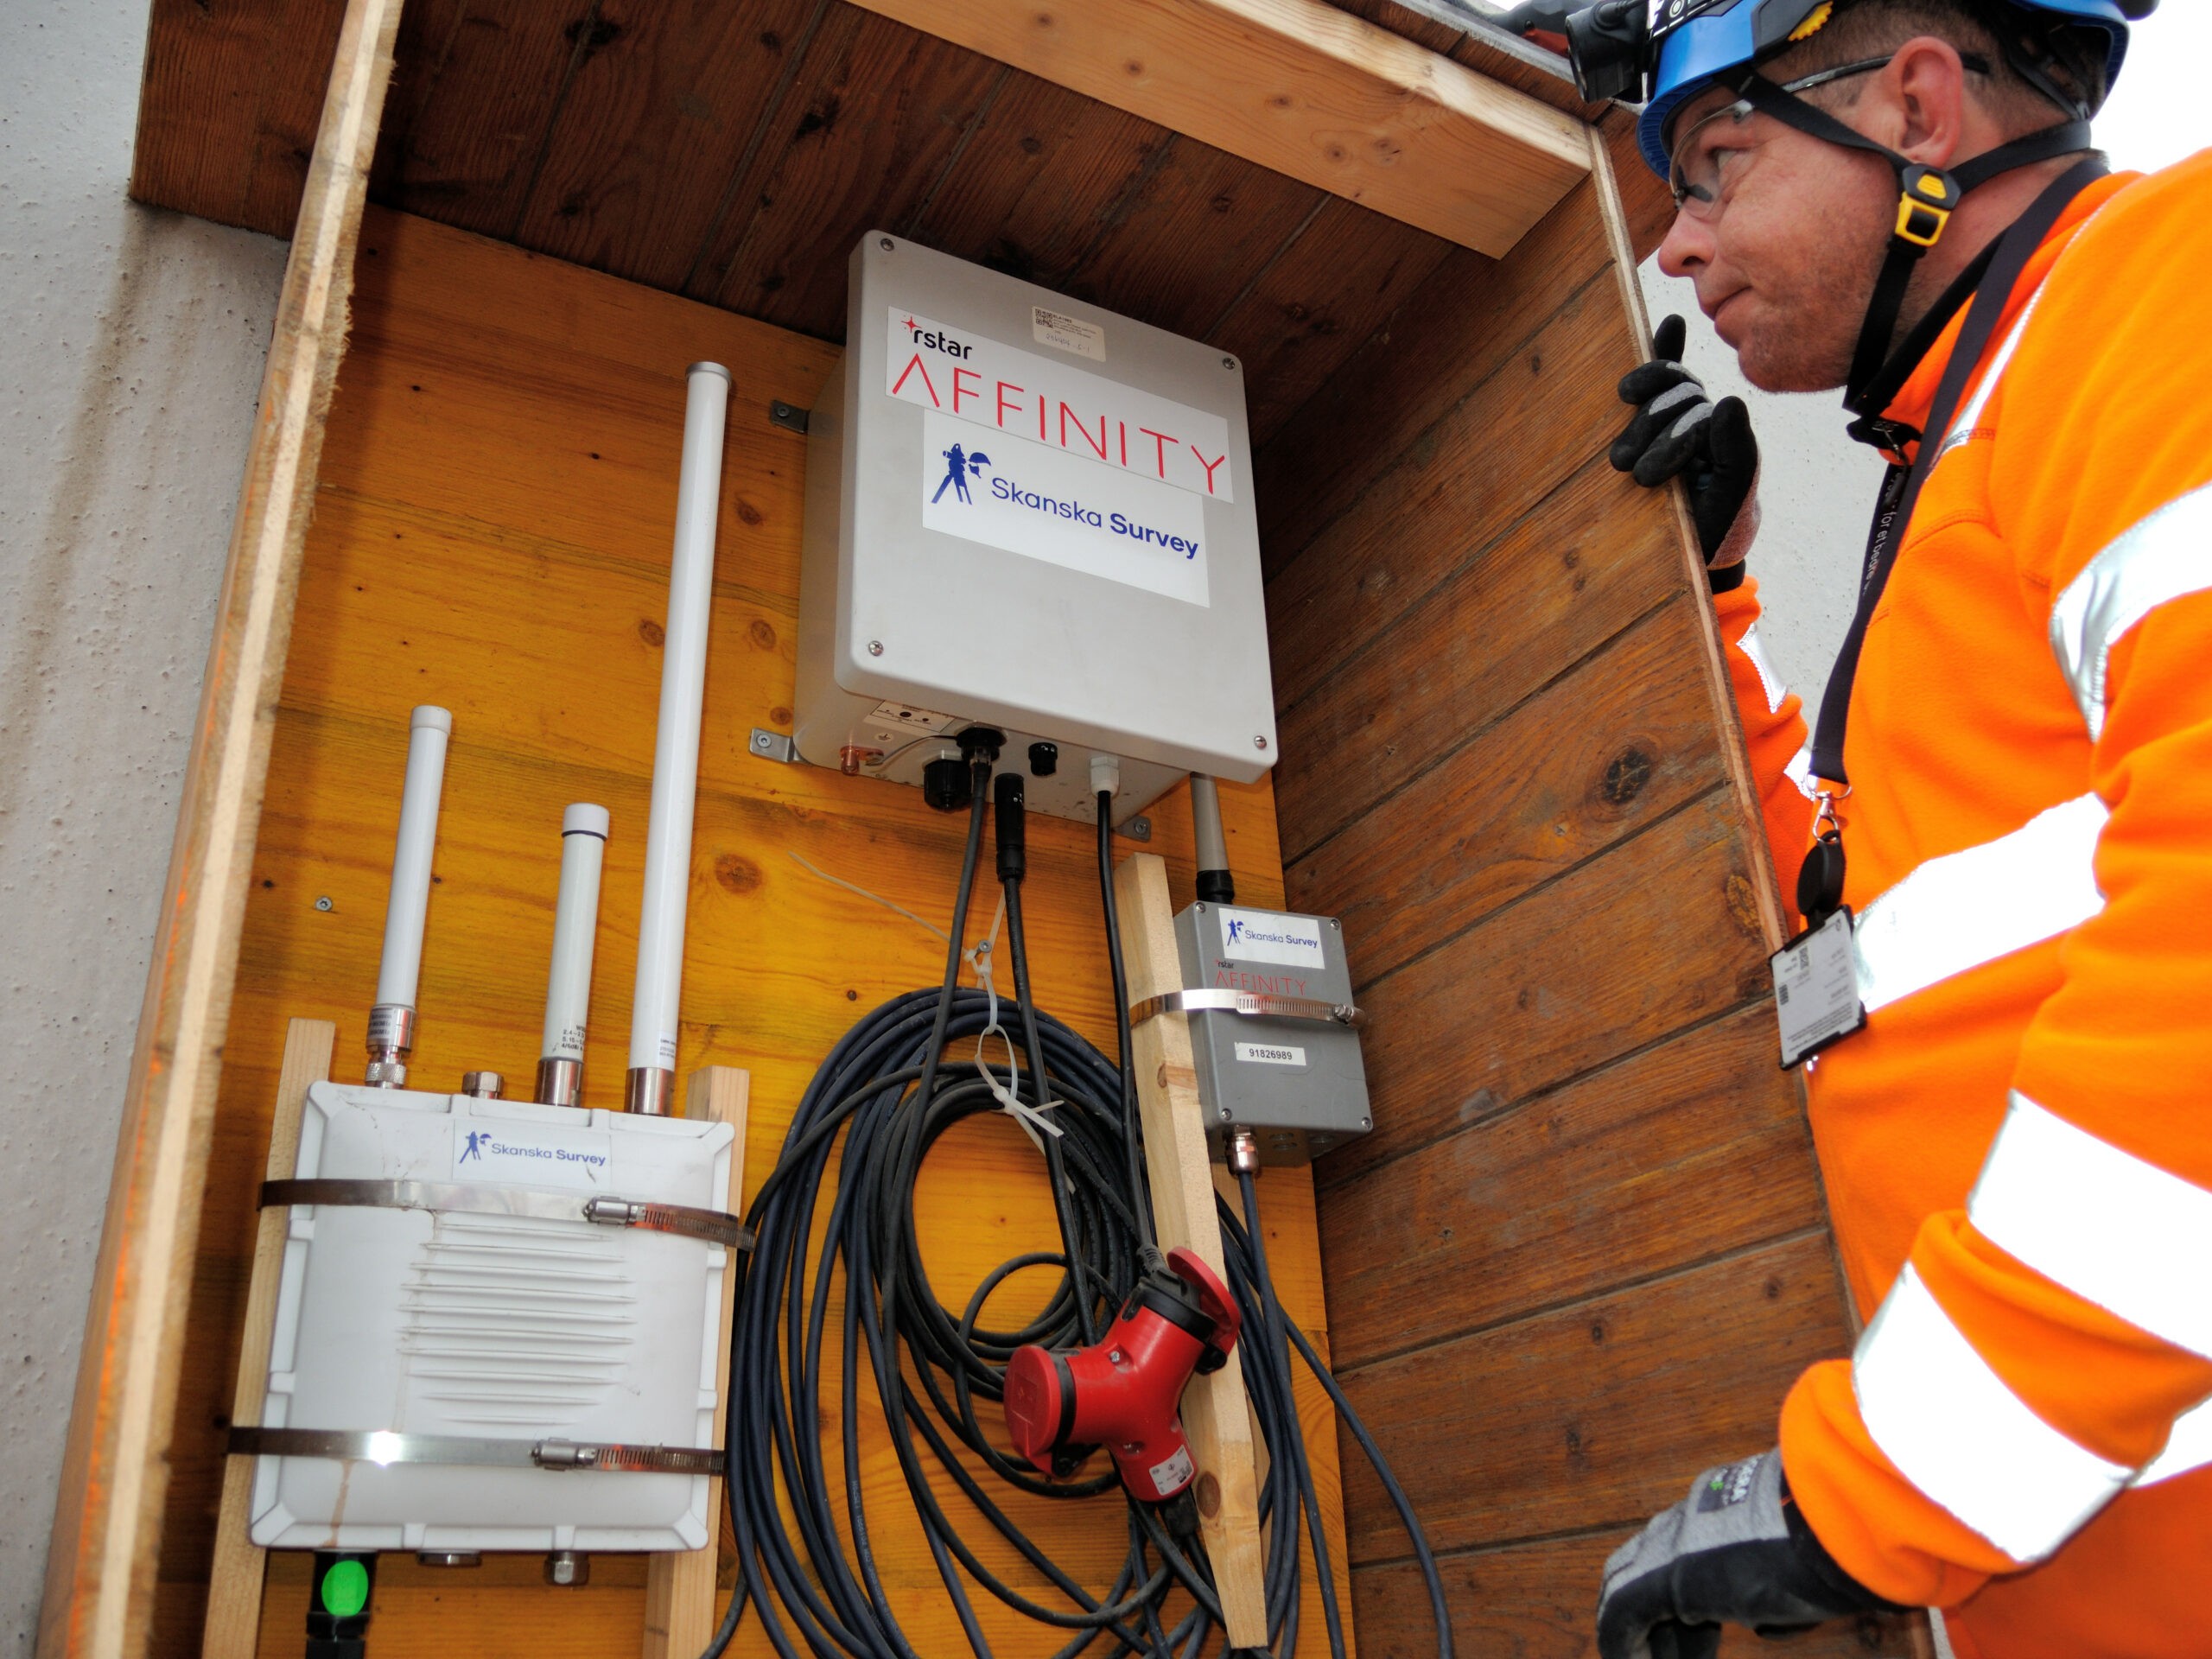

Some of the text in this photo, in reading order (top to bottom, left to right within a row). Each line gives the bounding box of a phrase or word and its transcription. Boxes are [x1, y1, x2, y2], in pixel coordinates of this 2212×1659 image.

[913, 328, 973, 360] rstar
[891, 353, 1226, 495] AFFINITY
[991, 477, 1200, 561] Skanska Survey
[1245, 930, 1318, 949] Skanska Survey
[1215, 970, 1306, 995] AFFINITY
[1249, 1048, 1293, 1060] 91826989
[491, 1142, 607, 1166] Skanska Survey
